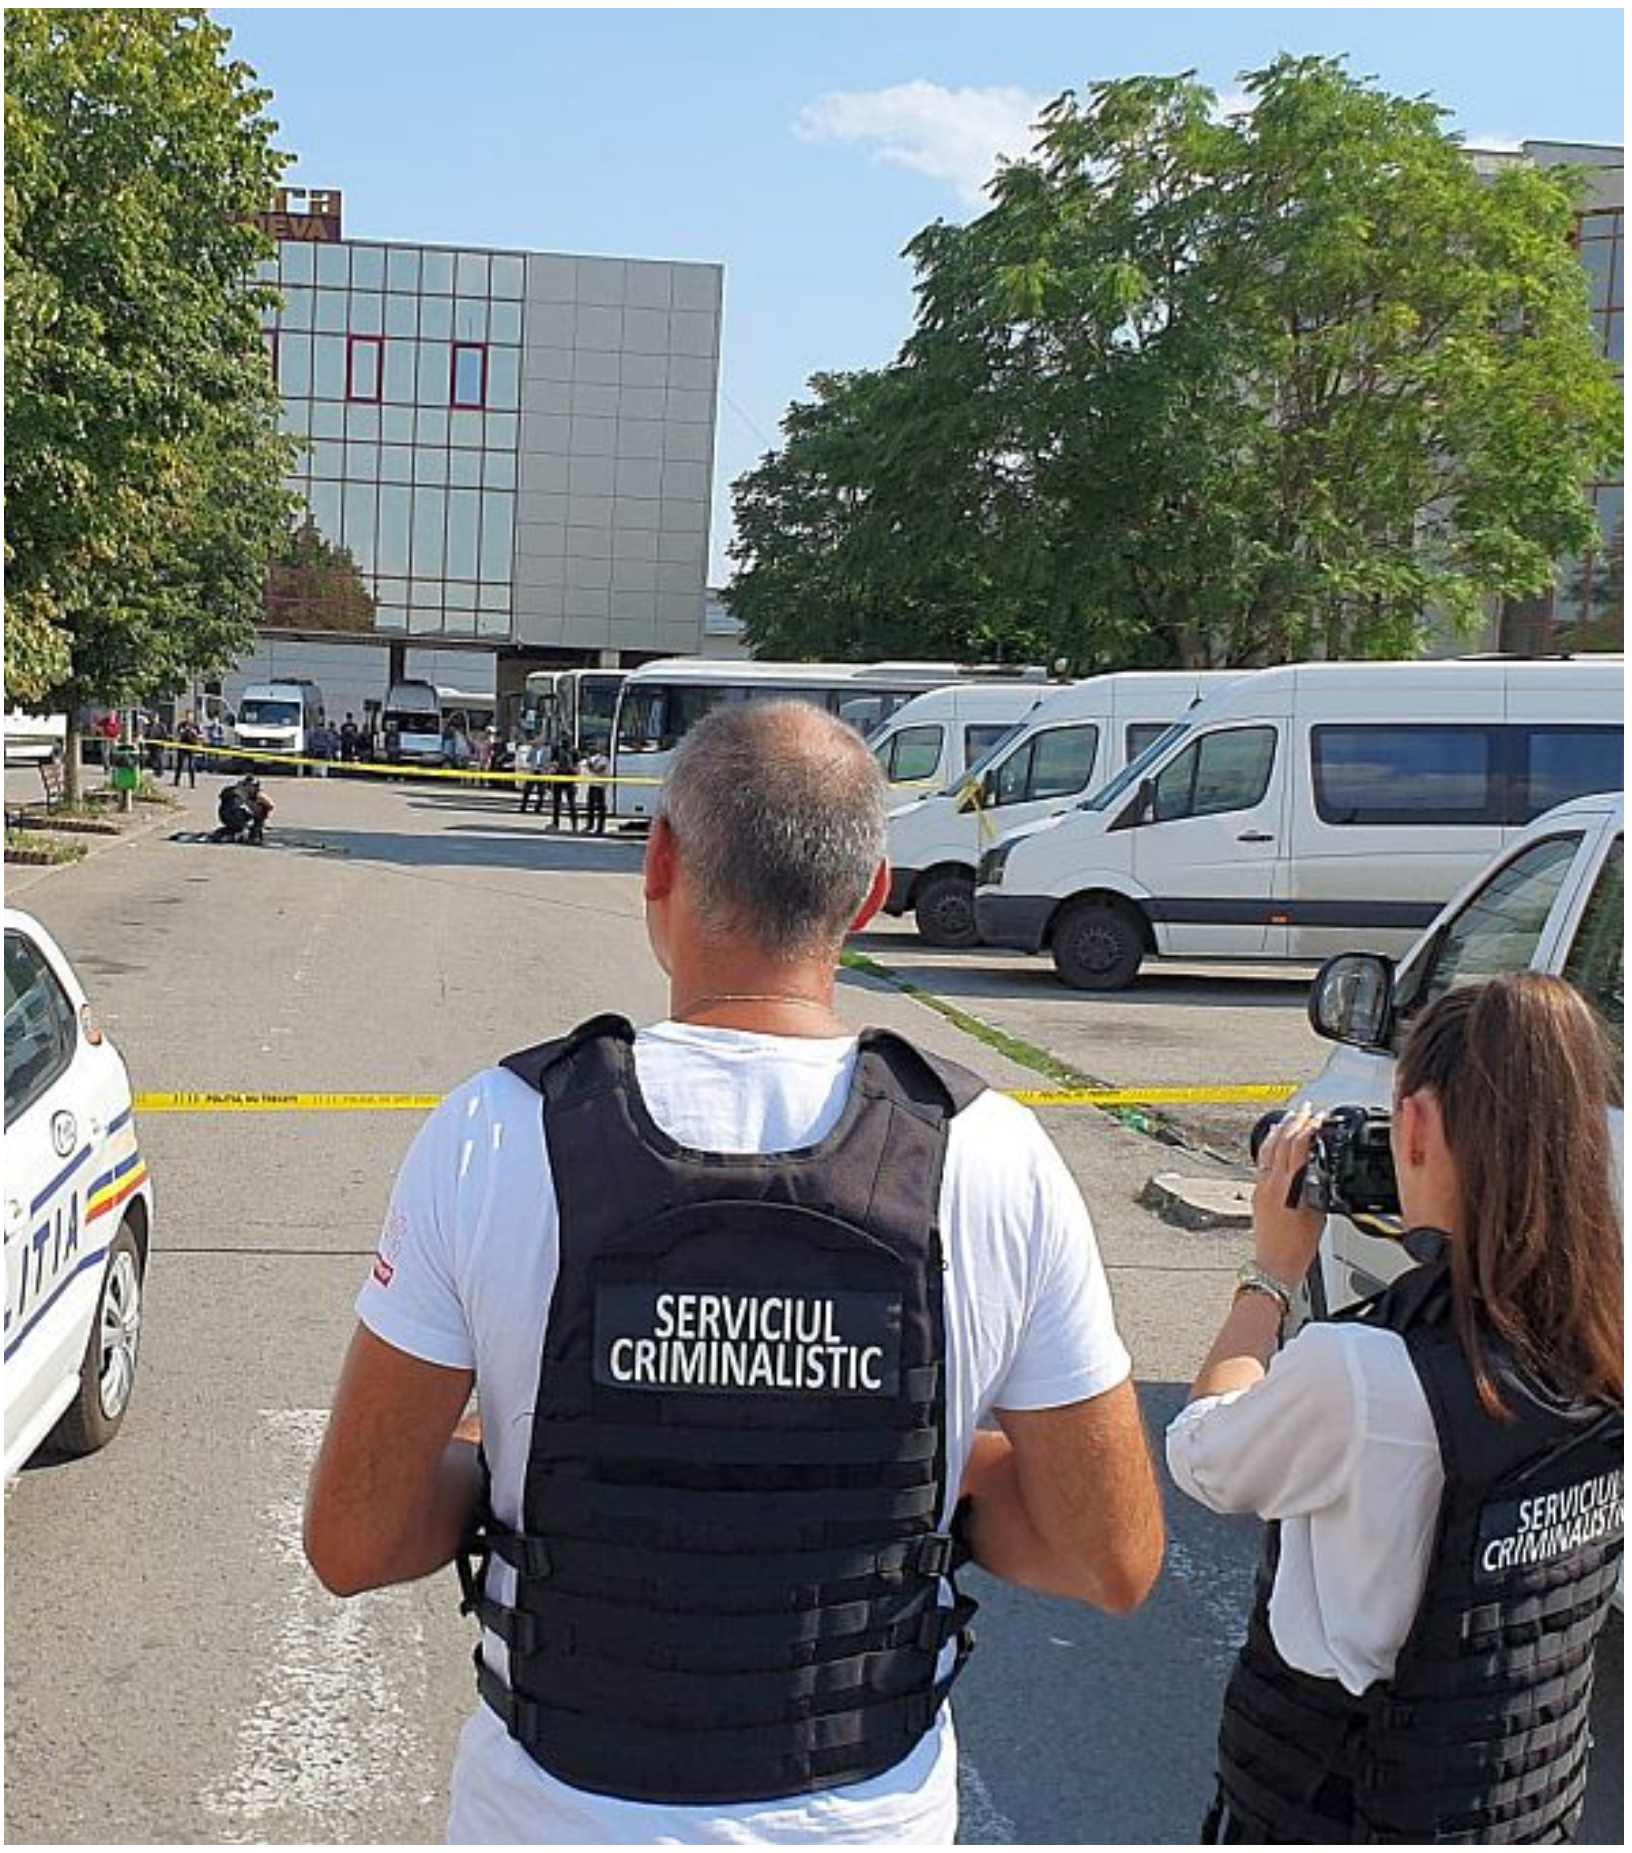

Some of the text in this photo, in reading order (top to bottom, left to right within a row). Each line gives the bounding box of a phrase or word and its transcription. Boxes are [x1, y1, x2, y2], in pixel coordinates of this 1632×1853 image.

[4, 1190, 77, 1332] ITIA
[653, 1294, 842, 1343] SERVICIUL
[609, 1337, 883, 1389] CRIMINALISTIC
